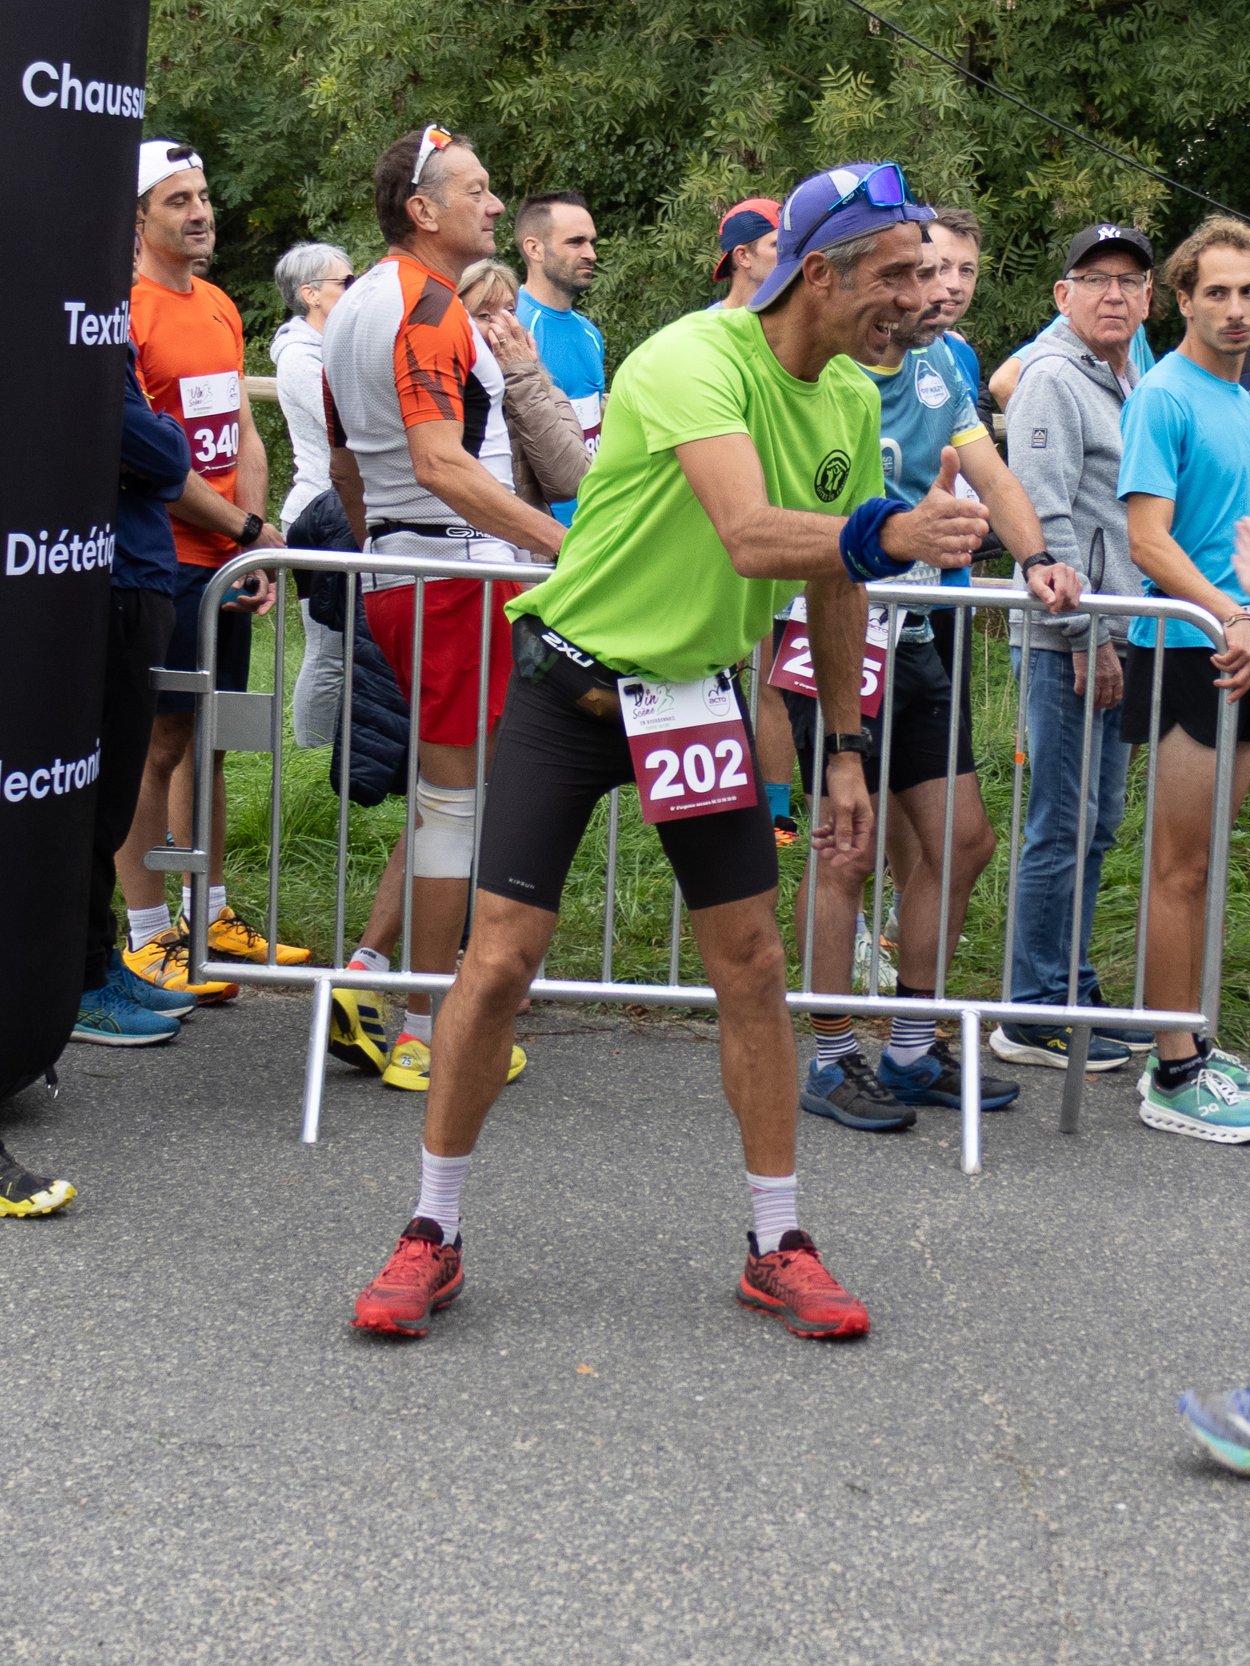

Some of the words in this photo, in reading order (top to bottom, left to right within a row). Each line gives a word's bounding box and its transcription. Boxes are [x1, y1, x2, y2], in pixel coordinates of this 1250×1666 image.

[193, 422, 239, 462] 340
[541, 631, 595, 668] 2XU
[782, 637, 882, 696] 25
[645, 739, 748, 801] 202
